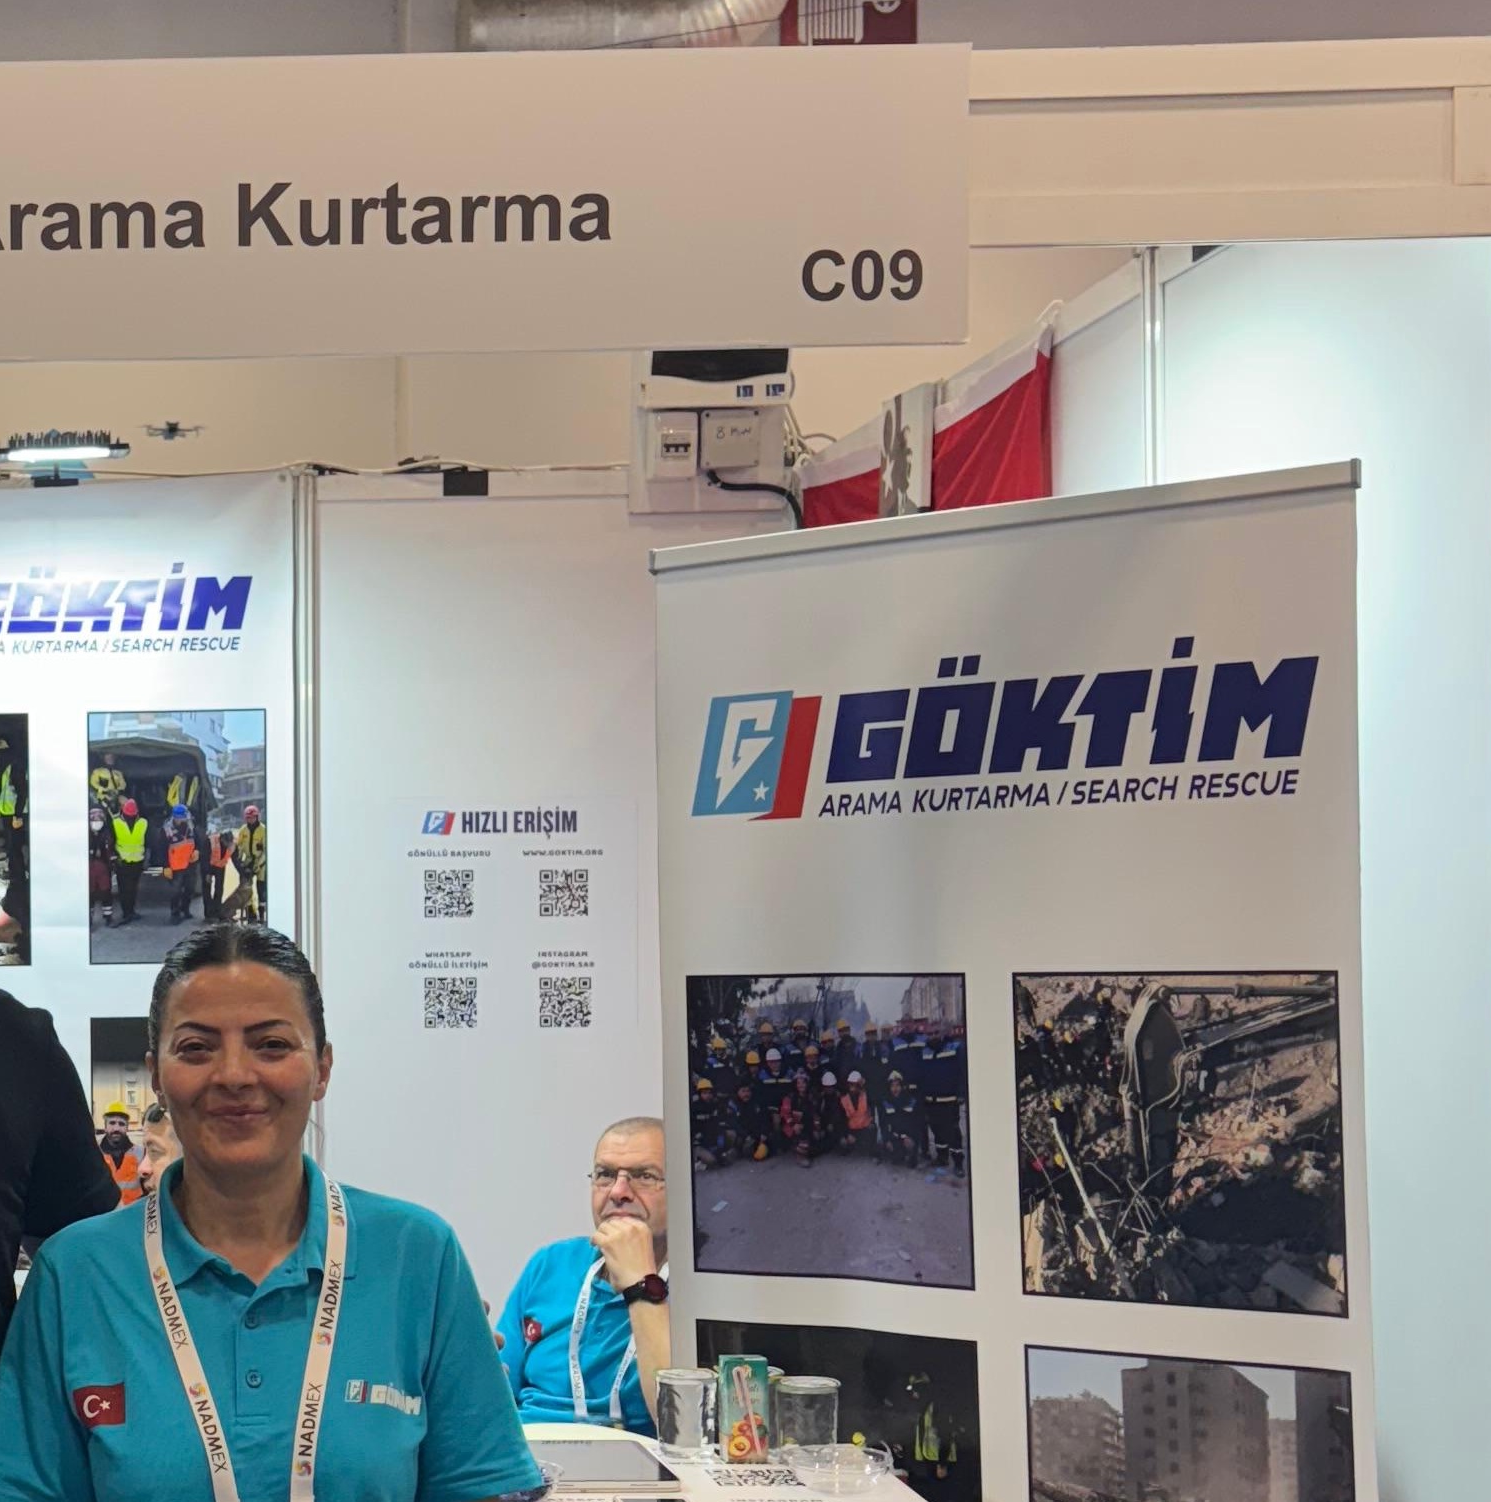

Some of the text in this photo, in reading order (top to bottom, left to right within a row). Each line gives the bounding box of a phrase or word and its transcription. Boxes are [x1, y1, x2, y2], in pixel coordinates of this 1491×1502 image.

[237, 182, 612, 247] Kurtarma
[801, 249, 924, 301] C09
[12, 639, 98, 654] KURTARMA
[111, 638, 174, 653] SEARCH
[179, 636, 241, 652] RESCUE
[825, 636, 1319, 784] GÖKTİM
[461, 806, 578, 840] HIZLI ERİŞİM
[818, 791, 903, 818] ARAMA
[912, 782, 1051, 813] KURTARMA
[1071, 775, 1178, 805] SEARCH
[1188, 769, 1300, 799] RESCUE
[157, 1282, 189, 1350] NADMEX
[319, 1260, 343, 1329] NADMEX
[194, 1399, 228, 1473] NADMEX
[298, 1382, 323, 1457] NADMEX
